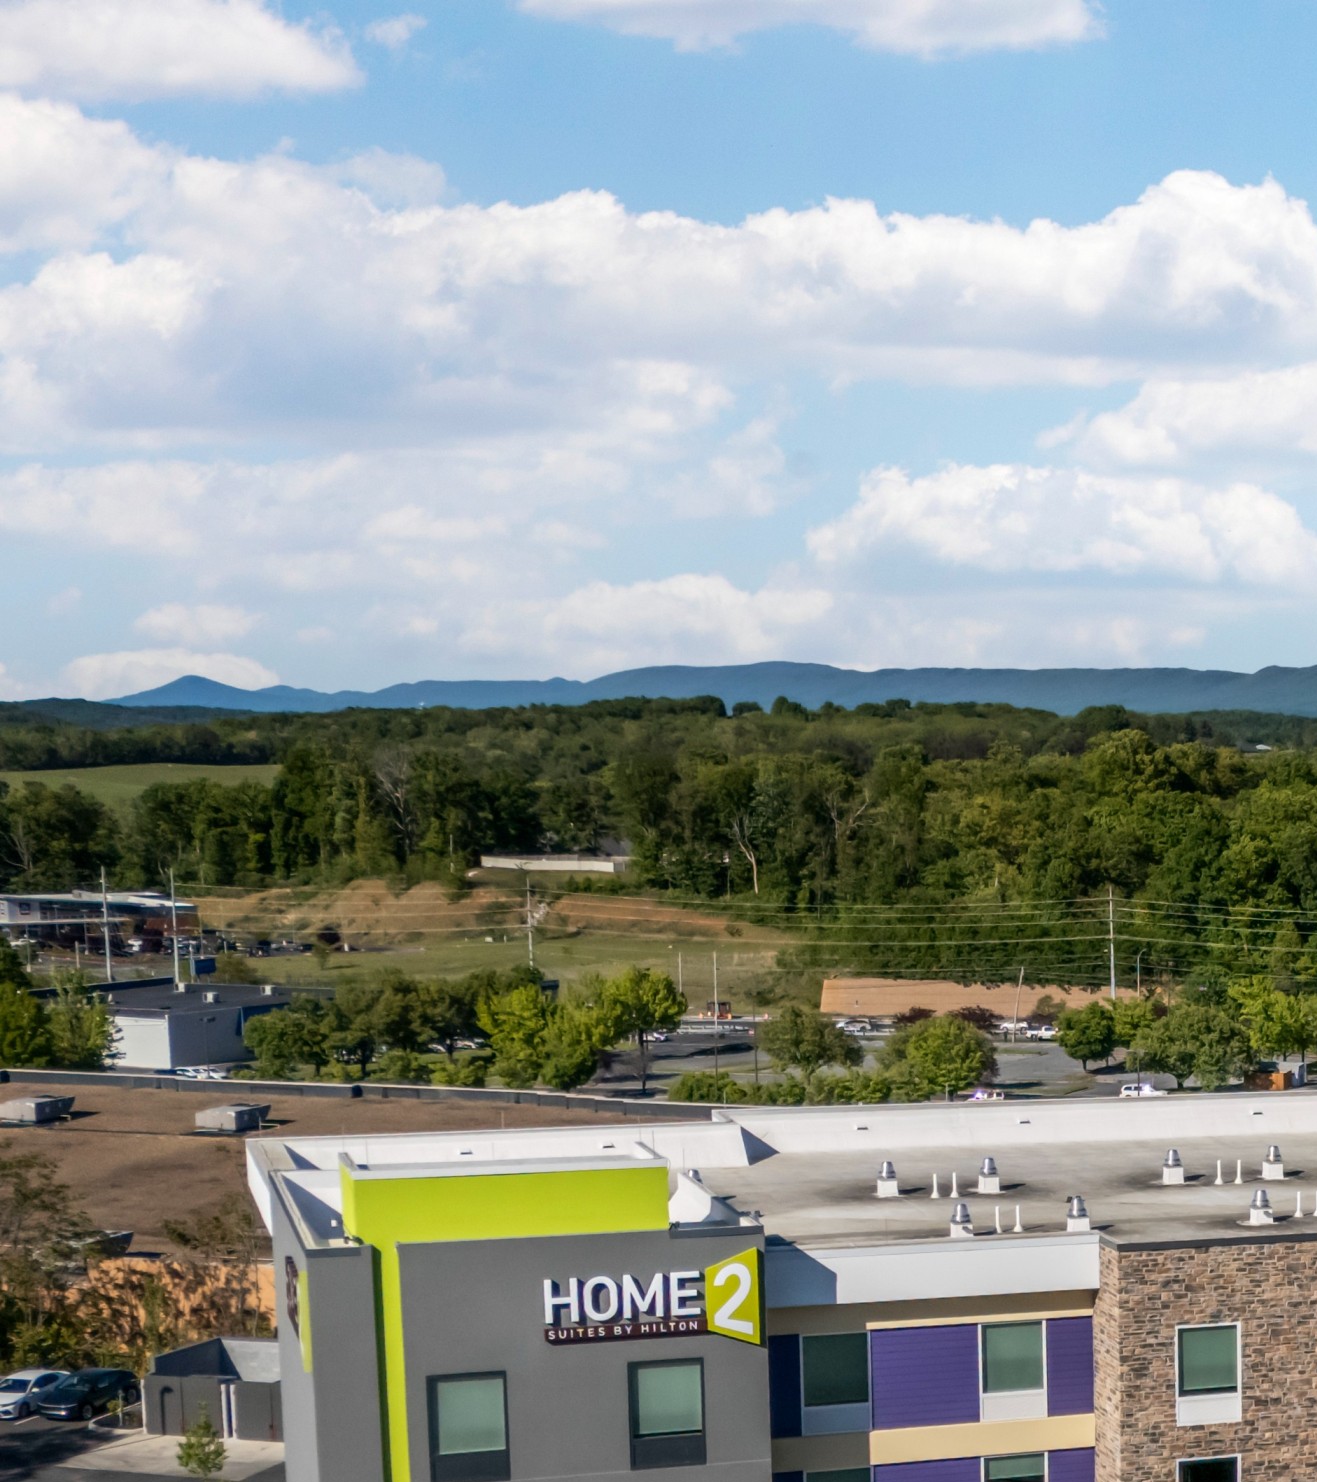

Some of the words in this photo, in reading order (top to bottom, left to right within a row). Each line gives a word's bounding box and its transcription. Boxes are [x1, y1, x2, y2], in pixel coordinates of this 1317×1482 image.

[543, 1270, 702, 1324] HOME
[712, 1262, 754, 1336] 2
[548, 1327, 606, 1340] SUITES
[613, 1325, 633, 1336] BY
[640, 1320, 699, 1333] HILTON
